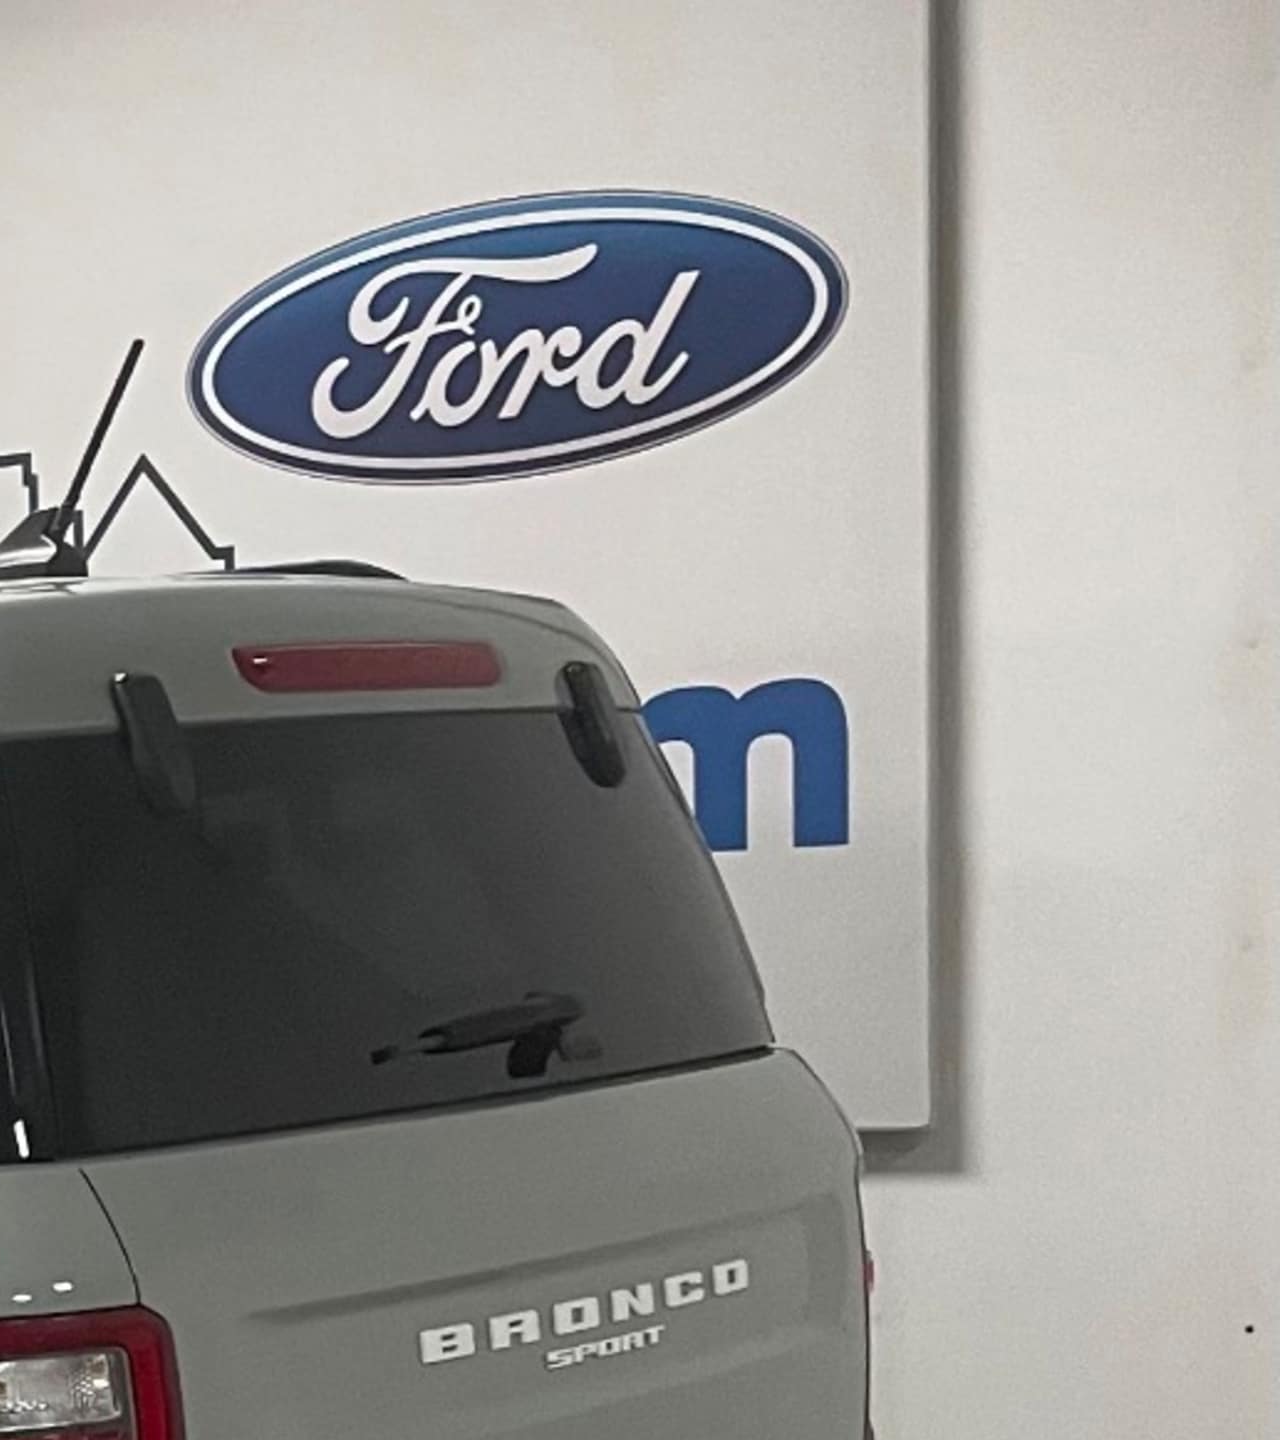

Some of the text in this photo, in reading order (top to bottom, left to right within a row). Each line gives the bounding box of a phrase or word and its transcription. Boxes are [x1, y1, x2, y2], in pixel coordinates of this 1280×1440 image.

[311, 243, 702, 439] Ford
[419, 1258, 749, 1364] BRONCO
[545, 1324, 666, 1370] SPORT
